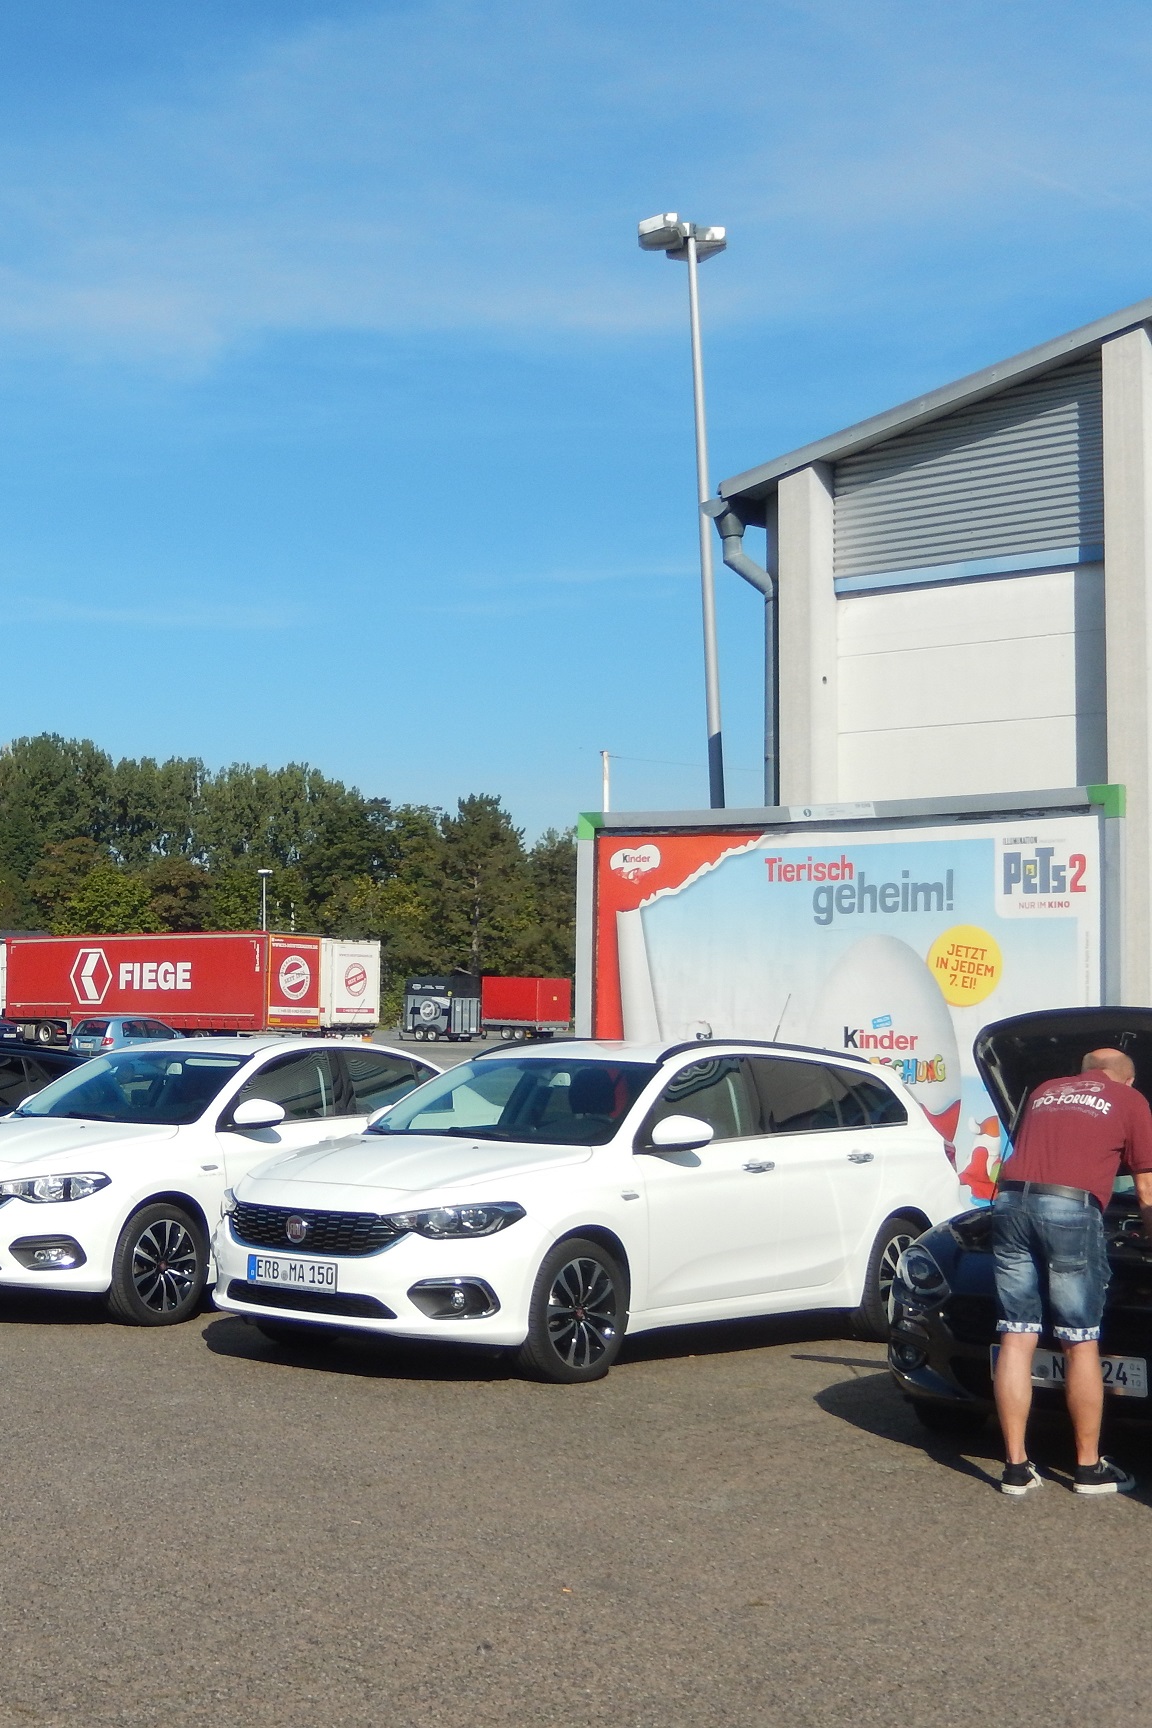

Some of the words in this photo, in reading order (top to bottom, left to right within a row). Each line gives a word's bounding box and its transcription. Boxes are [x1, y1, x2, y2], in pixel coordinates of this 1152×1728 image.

[764, 854, 854, 882] Tierisch
[1069, 853, 1086, 893] 2
[812, 868, 954, 926] geheim!
[1018, 901, 1035, 909] NUR
[1037, 901, 1046, 909] IM
[1048, 900, 1070, 908] KINO
[947, 944, 987, 960] JETZT
[119, 961, 192, 990] FIEGE
[936, 957, 949, 969] IN
[951, 959, 995, 977] JEDEM
[949, 974, 958, 987] 7.
[961, 976, 977, 990] EI!
[257, 1259, 279, 1279] ERB
[289, 1263, 305, 1282] MA
[308, 1265, 334, 1285] 150
[1102, 1361, 1128, 1386] 24
